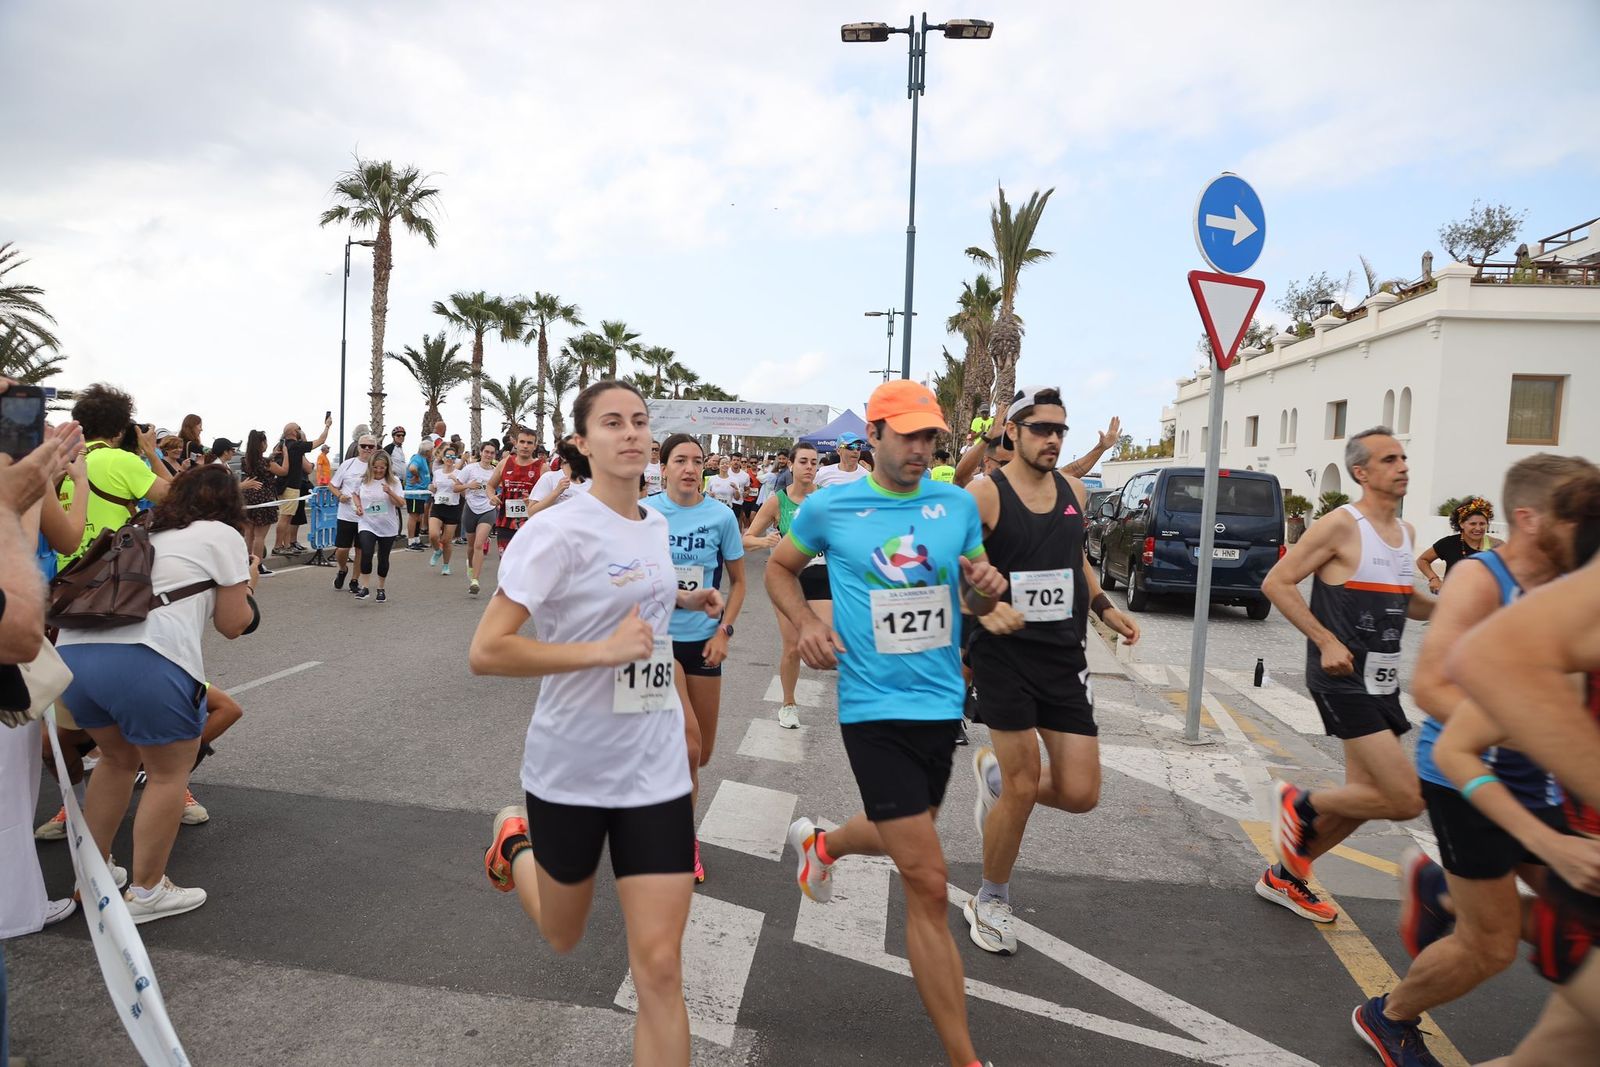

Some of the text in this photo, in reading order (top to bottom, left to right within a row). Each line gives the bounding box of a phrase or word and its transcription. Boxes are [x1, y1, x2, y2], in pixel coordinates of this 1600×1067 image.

[697, 406, 709, 414] 3A
[711, 406, 753, 415] CARRERA
[510, 505, 526, 513] 158
[669, 532, 706, 552] erja
[1222, 550, 1236, 558] HNR
[1025, 587, 1065, 607] 702
[883, 607, 945, 634] 1271
[624, 662, 672, 689] 1185
